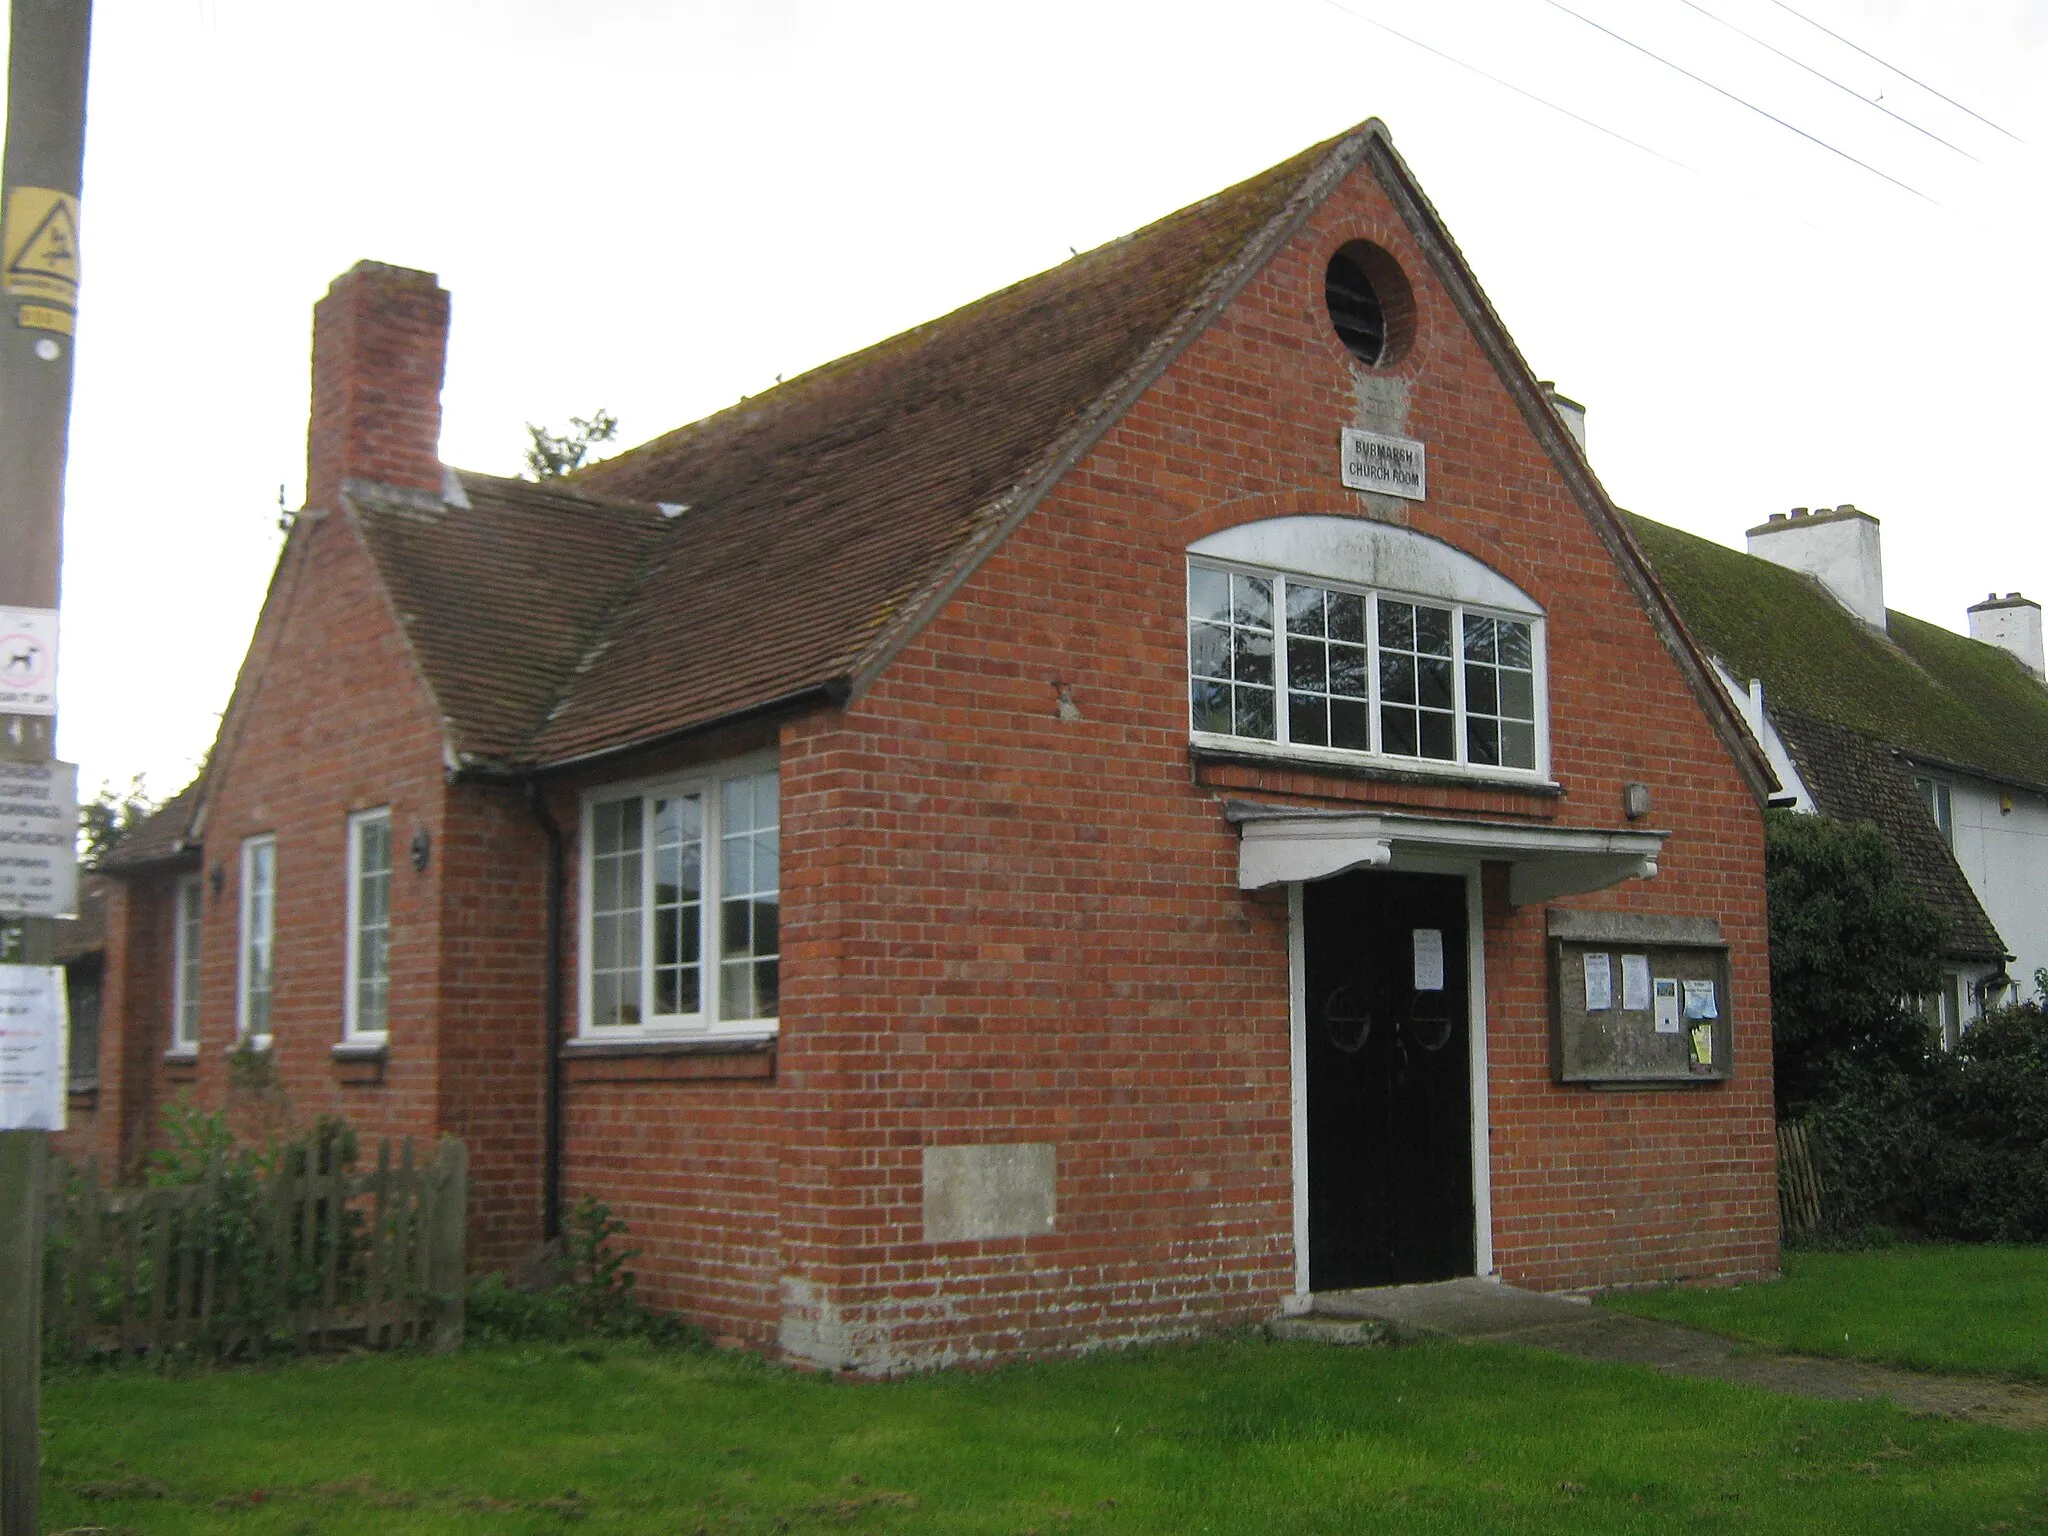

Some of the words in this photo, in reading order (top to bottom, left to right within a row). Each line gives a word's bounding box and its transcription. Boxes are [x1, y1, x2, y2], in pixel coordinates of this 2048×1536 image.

[1355, 441, 1413, 463] BURMARSH
[1349, 462, 1390, 480] CHURCH
[1393, 469, 1419, 486] ROOM
